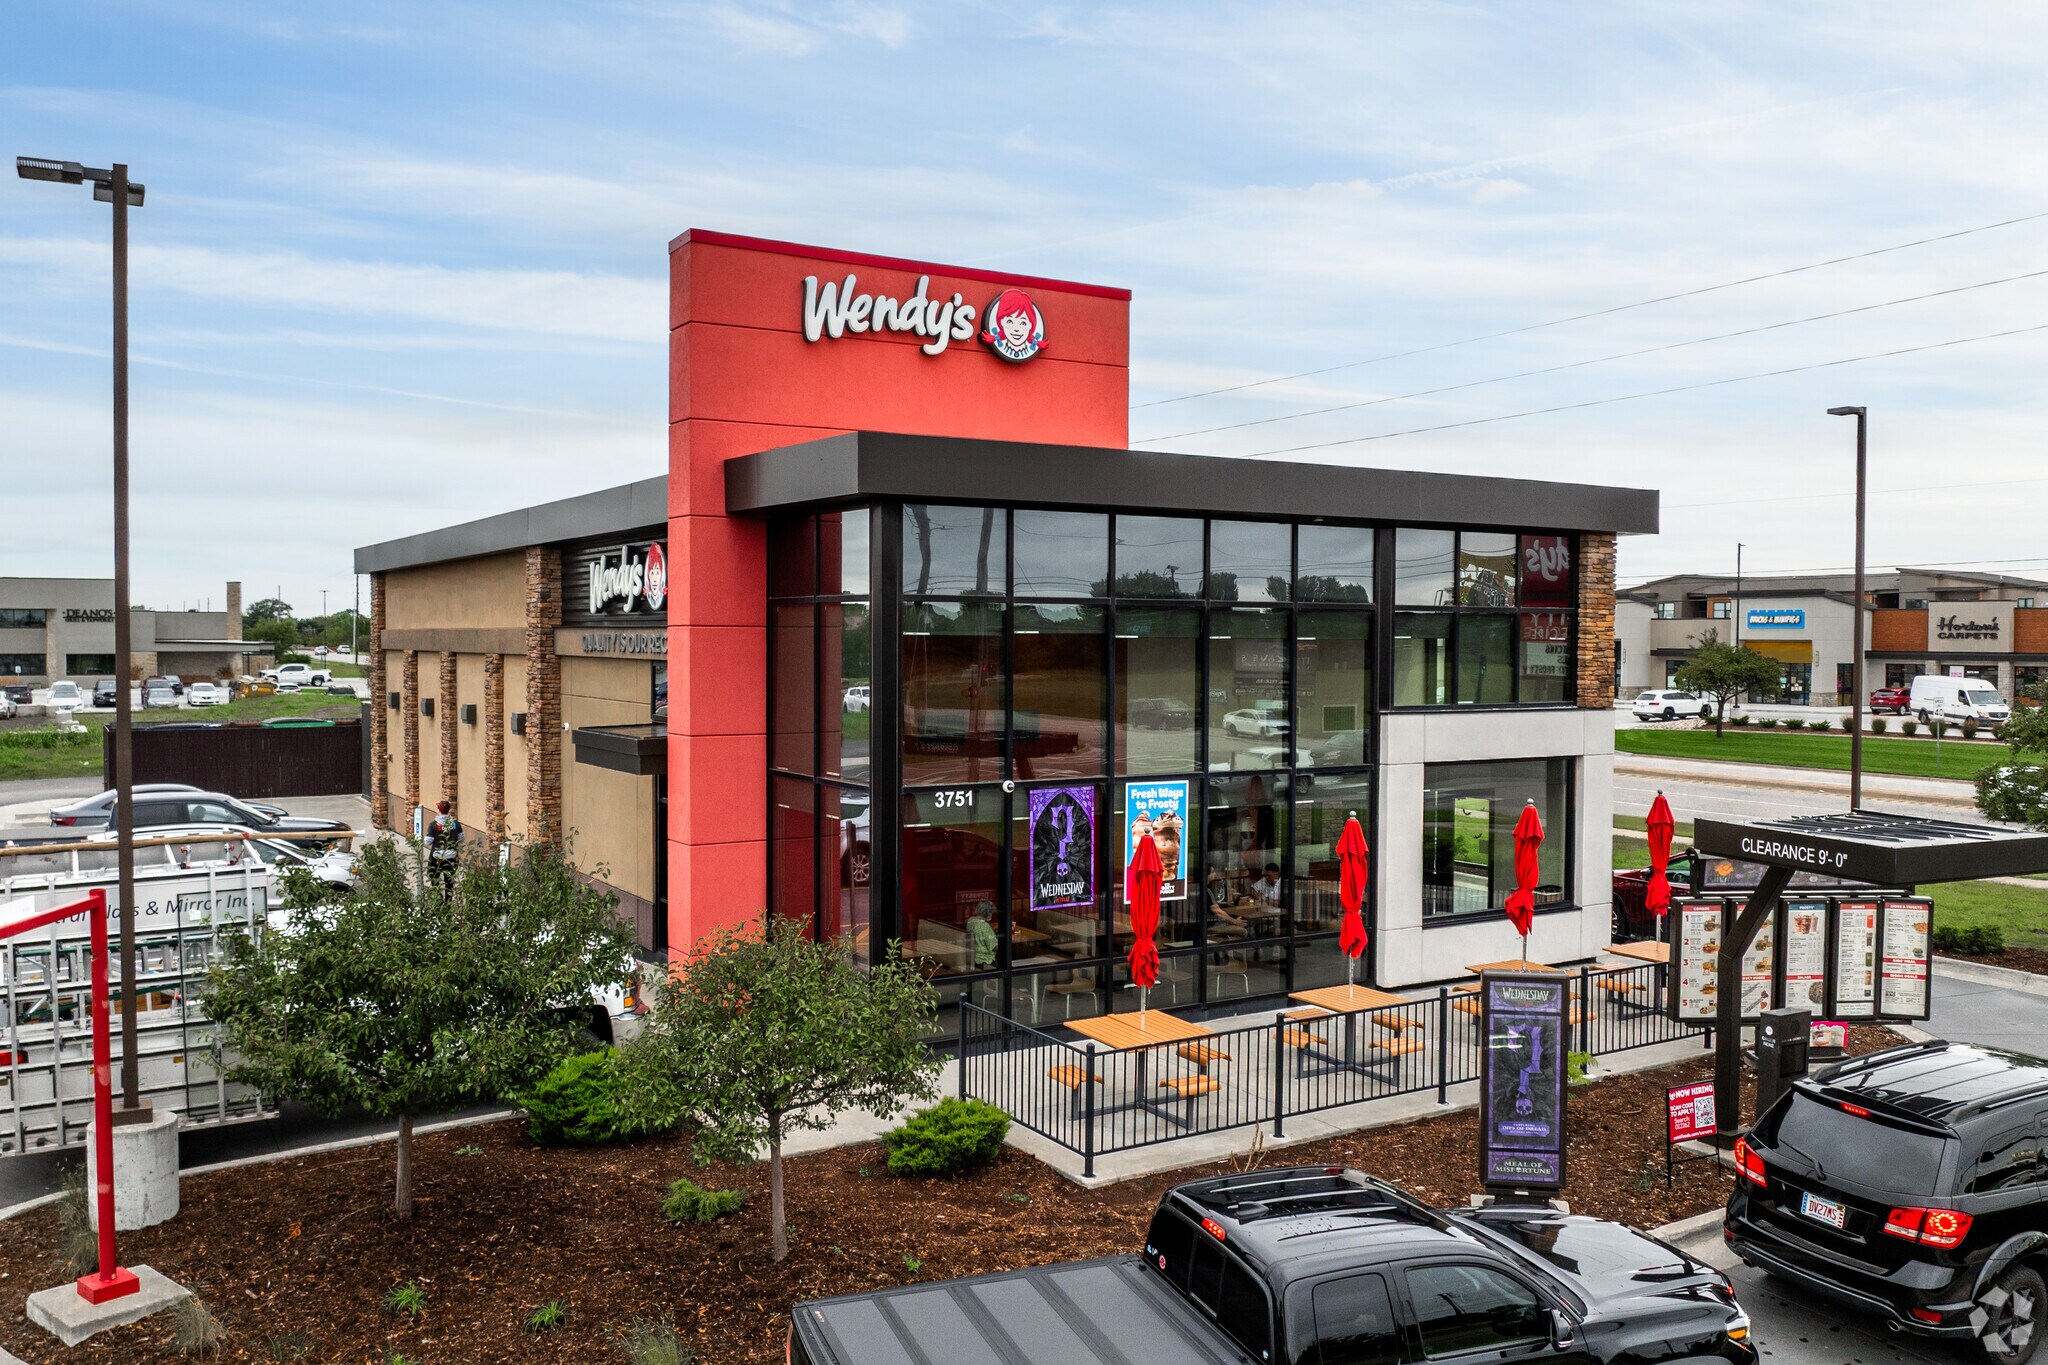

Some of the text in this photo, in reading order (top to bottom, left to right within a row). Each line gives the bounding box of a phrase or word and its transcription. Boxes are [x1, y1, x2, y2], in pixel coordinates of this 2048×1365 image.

[802, 274, 976, 356] Wendy's
[589, 545, 643, 614] Wendy's
[66, 609, 113, 619] DEANO'S
[1936, 614, 2000, 631] Horton's
[582, 633, 617, 653] QUALITY
[628, 633, 648, 653] OUR
[1938, 632, 1999, 640] CARPETS
[1934, 708, 1944, 716] 40
[934, 790, 973, 808] 3751
[1131, 787, 1184, 799] Fresh Ways
[1136, 799, 1179, 810] to Frosty
[1741, 838, 1815, 863] CLEARANCE
[1040, 881, 1085, 898] WEDNESDAY
[146, 901, 159, 916] &
[166, 898, 222, 914] Mirror
[226, 895, 255, 908] Inc.
[1502, 987, 1549, 1002] WEDNESDAY
[1675, 1085, 1713, 1098] NOW HIRING
